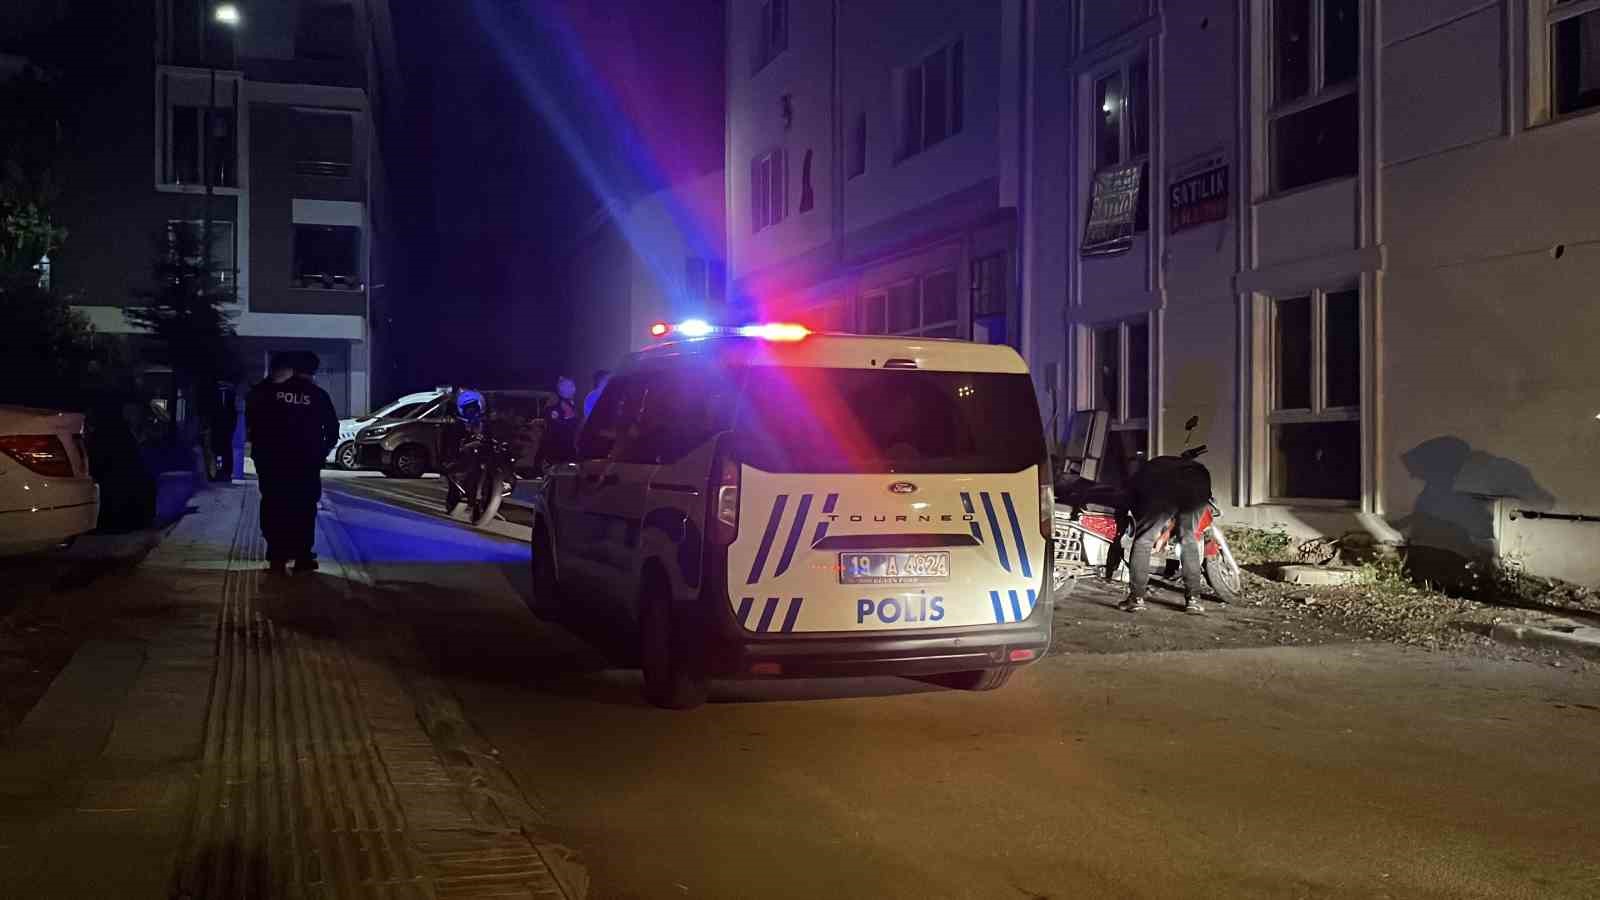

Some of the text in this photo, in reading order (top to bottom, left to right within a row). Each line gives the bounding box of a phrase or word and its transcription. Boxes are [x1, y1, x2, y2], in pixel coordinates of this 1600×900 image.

[1170, 168, 1228, 208] SATILIK
[828, 514, 974, 522] TOURNEO
[850, 556, 870, 576] 19
[857, 589, 945, 624] POLİS
